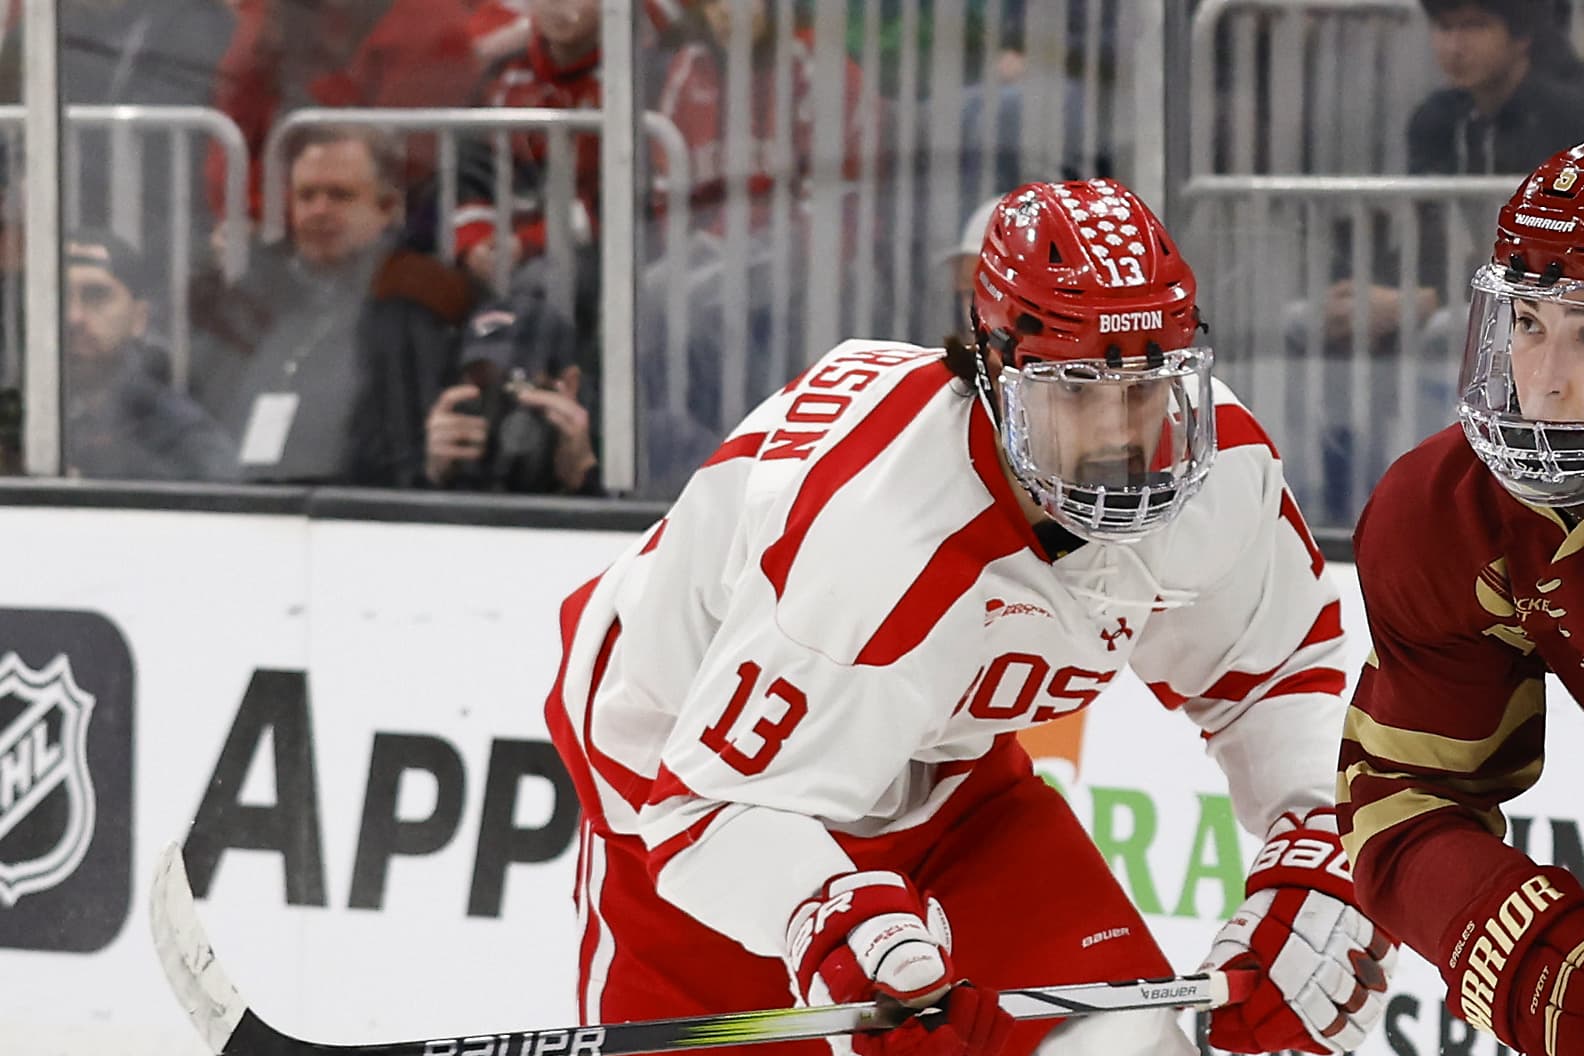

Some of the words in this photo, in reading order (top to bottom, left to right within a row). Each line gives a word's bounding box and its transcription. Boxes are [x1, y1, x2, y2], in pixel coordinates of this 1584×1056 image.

[1515, 212, 1577, 233] WARRIOR
[1101, 256, 1147, 288] 13
[1099, 310, 1164, 334] BOSTON
[699, 660, 808, 777] 13
[0, 720, 62, 809] HL
